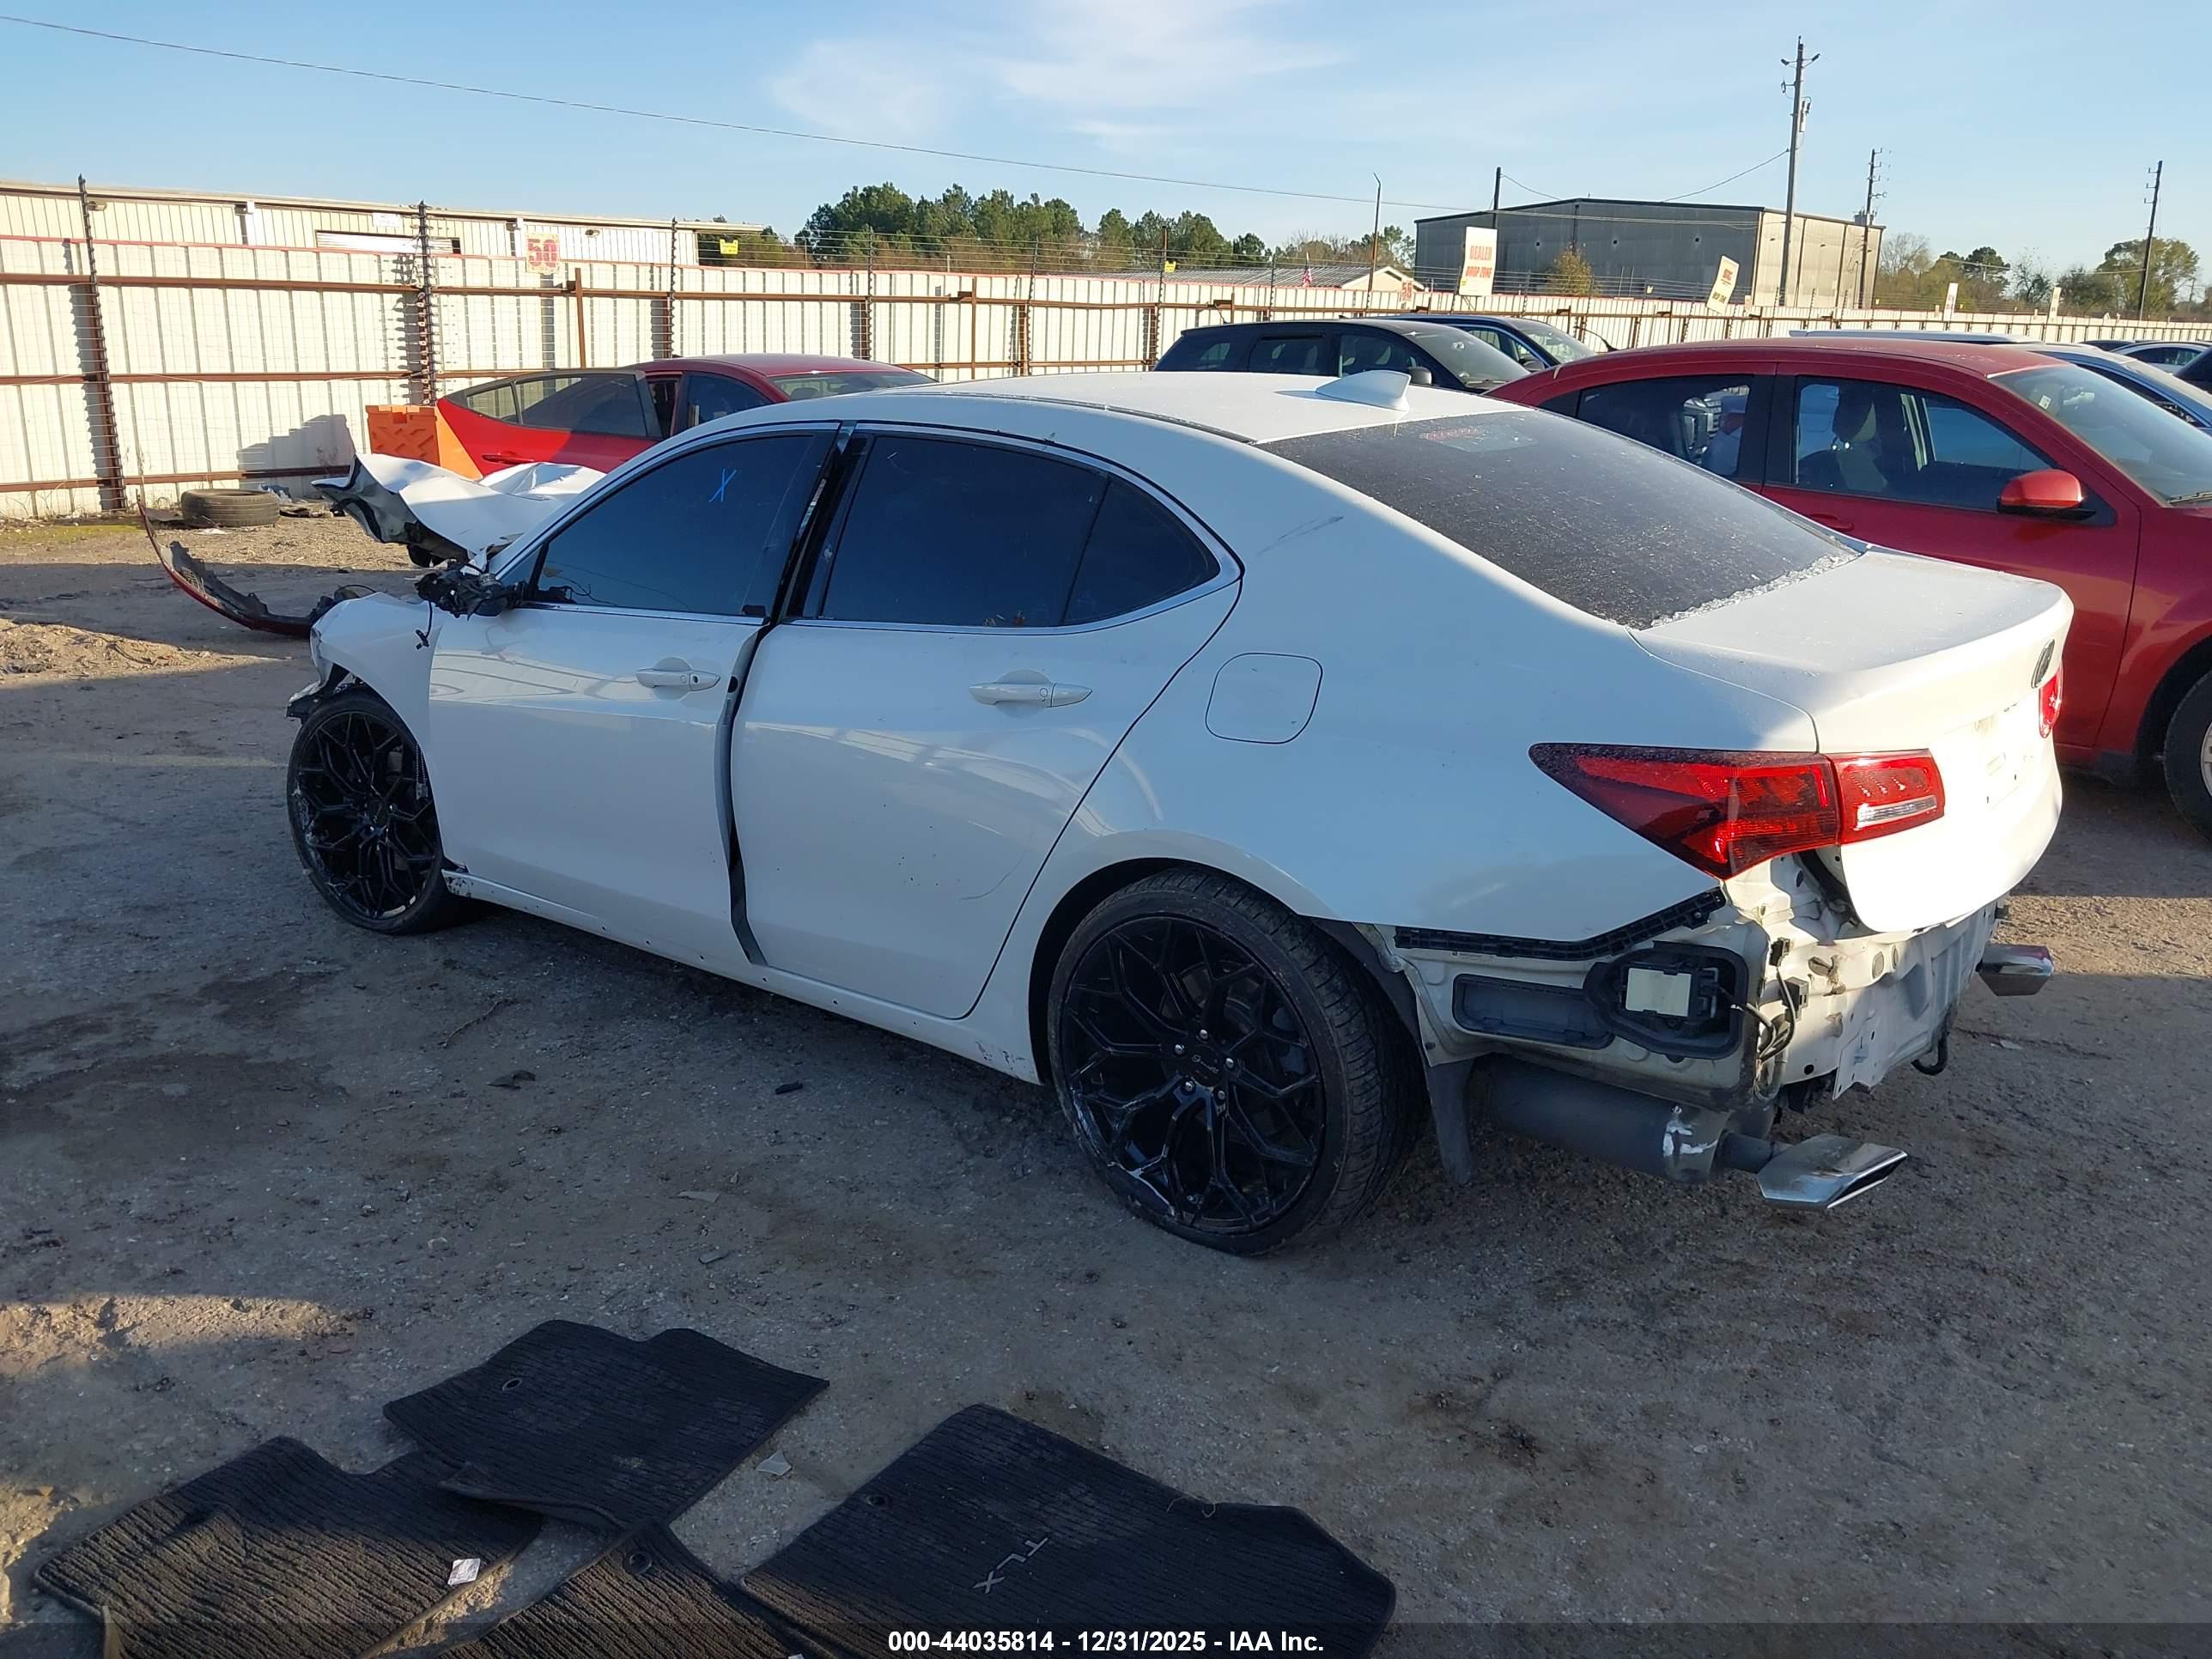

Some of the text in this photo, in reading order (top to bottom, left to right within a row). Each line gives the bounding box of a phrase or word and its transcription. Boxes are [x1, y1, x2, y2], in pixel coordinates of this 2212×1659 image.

[527, 239, 556, 267] 50
[1470, 246, 1492, 261] DEALER
[1466, 266, 1480, 277] DROP
[972, 1537, 1048, 1594] TLX
